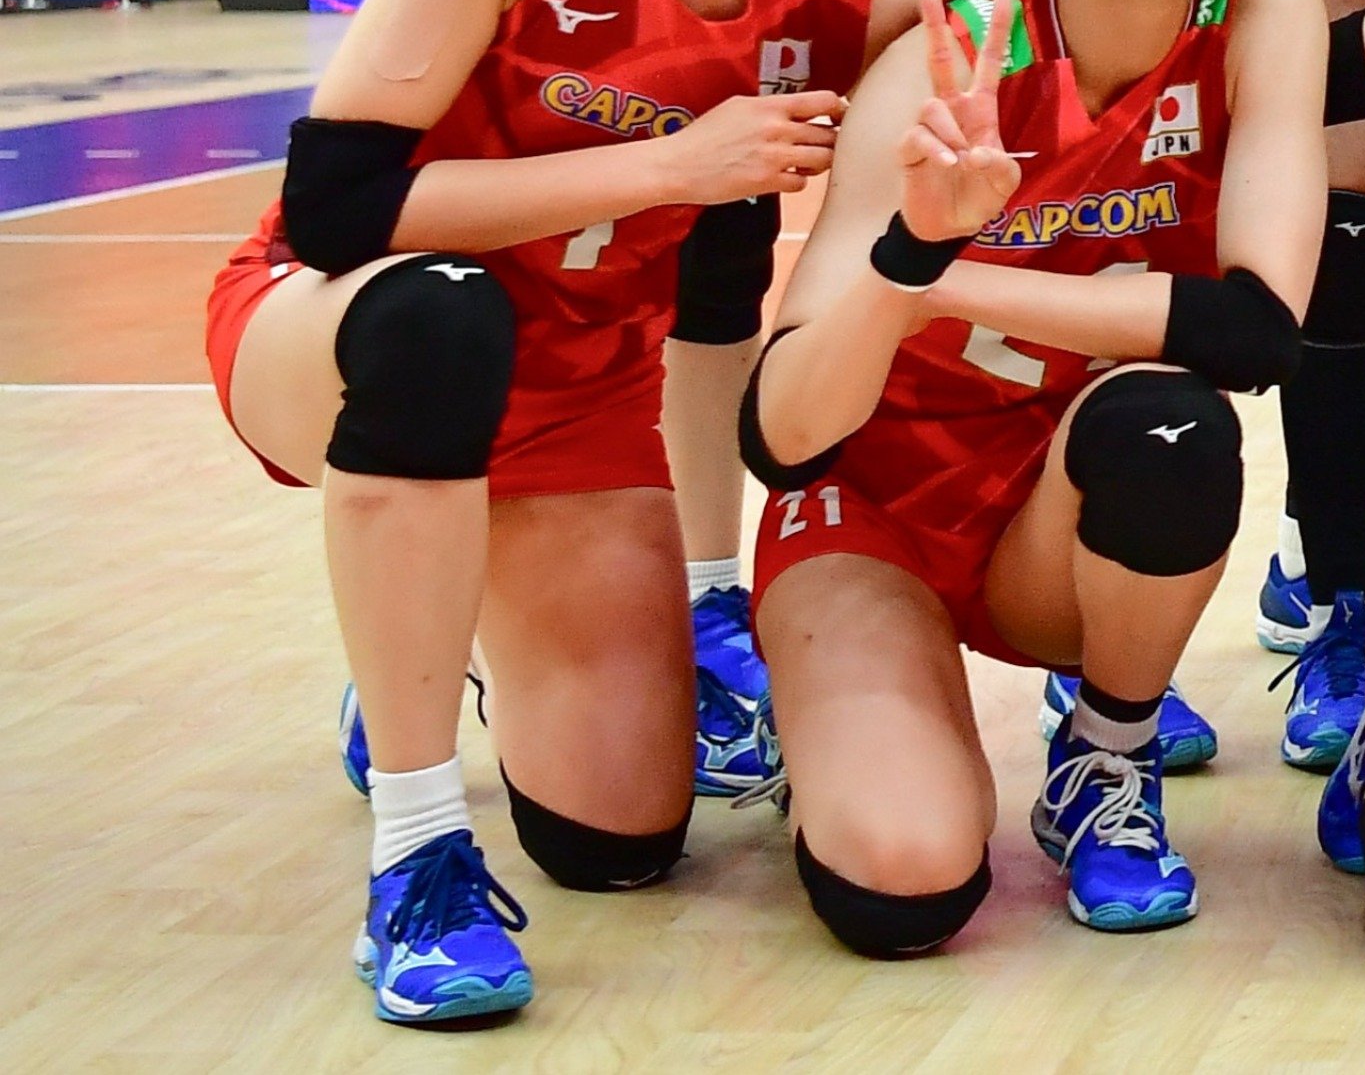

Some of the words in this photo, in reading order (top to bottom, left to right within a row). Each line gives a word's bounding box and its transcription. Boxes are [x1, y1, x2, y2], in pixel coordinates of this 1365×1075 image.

[541, 71, 696, 140] CAPC
[1152, 131, 1191, 157] JPN
[775, 485, 842, 541] 21
